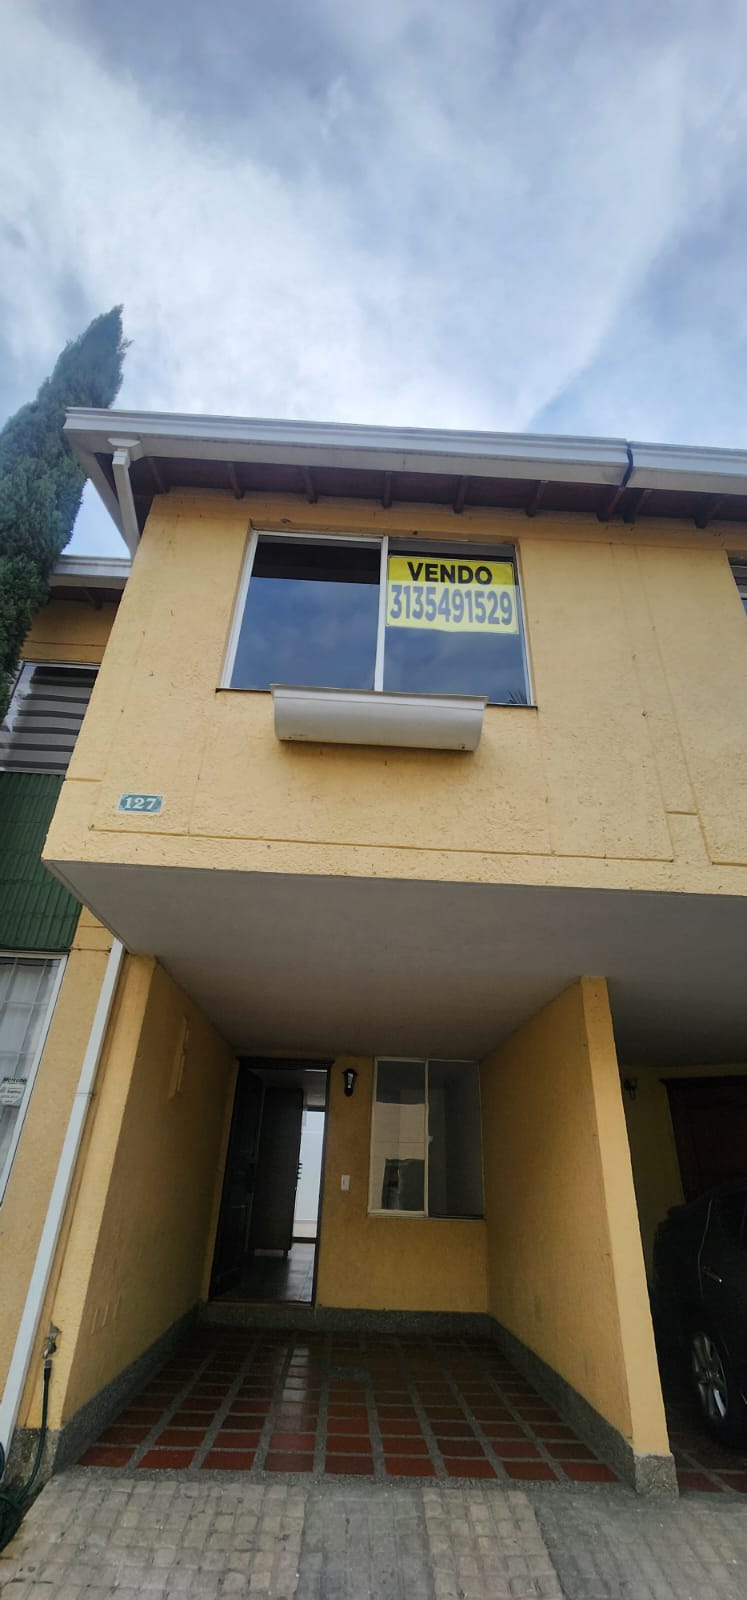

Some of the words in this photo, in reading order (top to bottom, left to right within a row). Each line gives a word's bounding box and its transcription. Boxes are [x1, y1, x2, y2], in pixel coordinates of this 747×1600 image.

[407, 562, 493, 585] VENDO
[390, 584, 513, 626] 3135491529
[124, 797, 158, 810] 127
